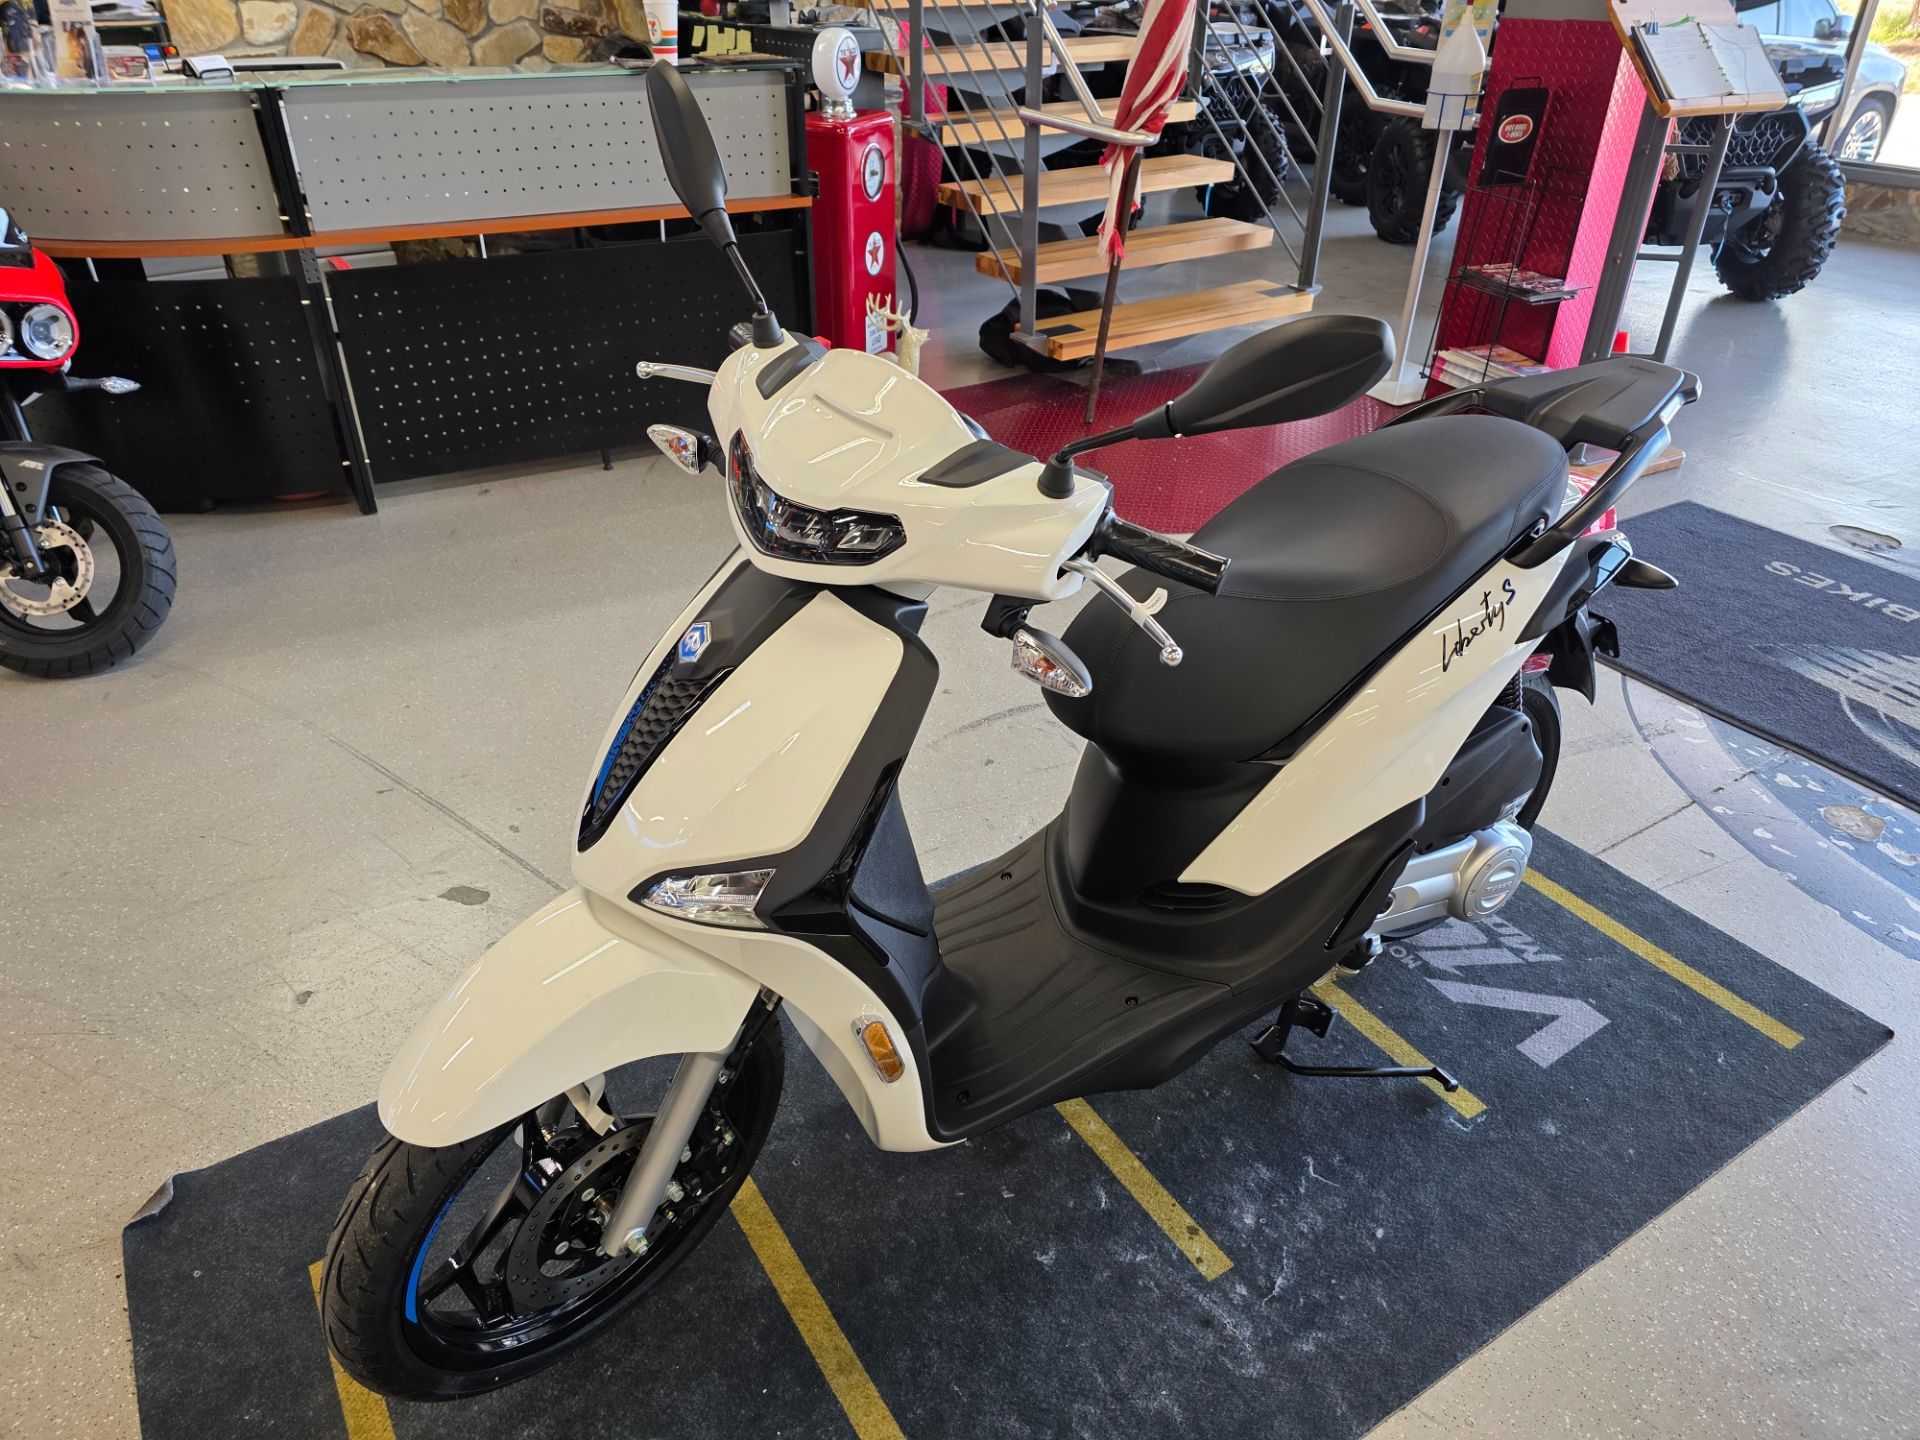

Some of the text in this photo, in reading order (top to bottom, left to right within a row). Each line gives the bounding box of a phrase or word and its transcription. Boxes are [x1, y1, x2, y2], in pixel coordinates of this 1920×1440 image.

[18, 459, 45, 471] ABS
[1764, 560, 1920, 623] BIKES
[1442, 590, 1505, 673] Liberty
